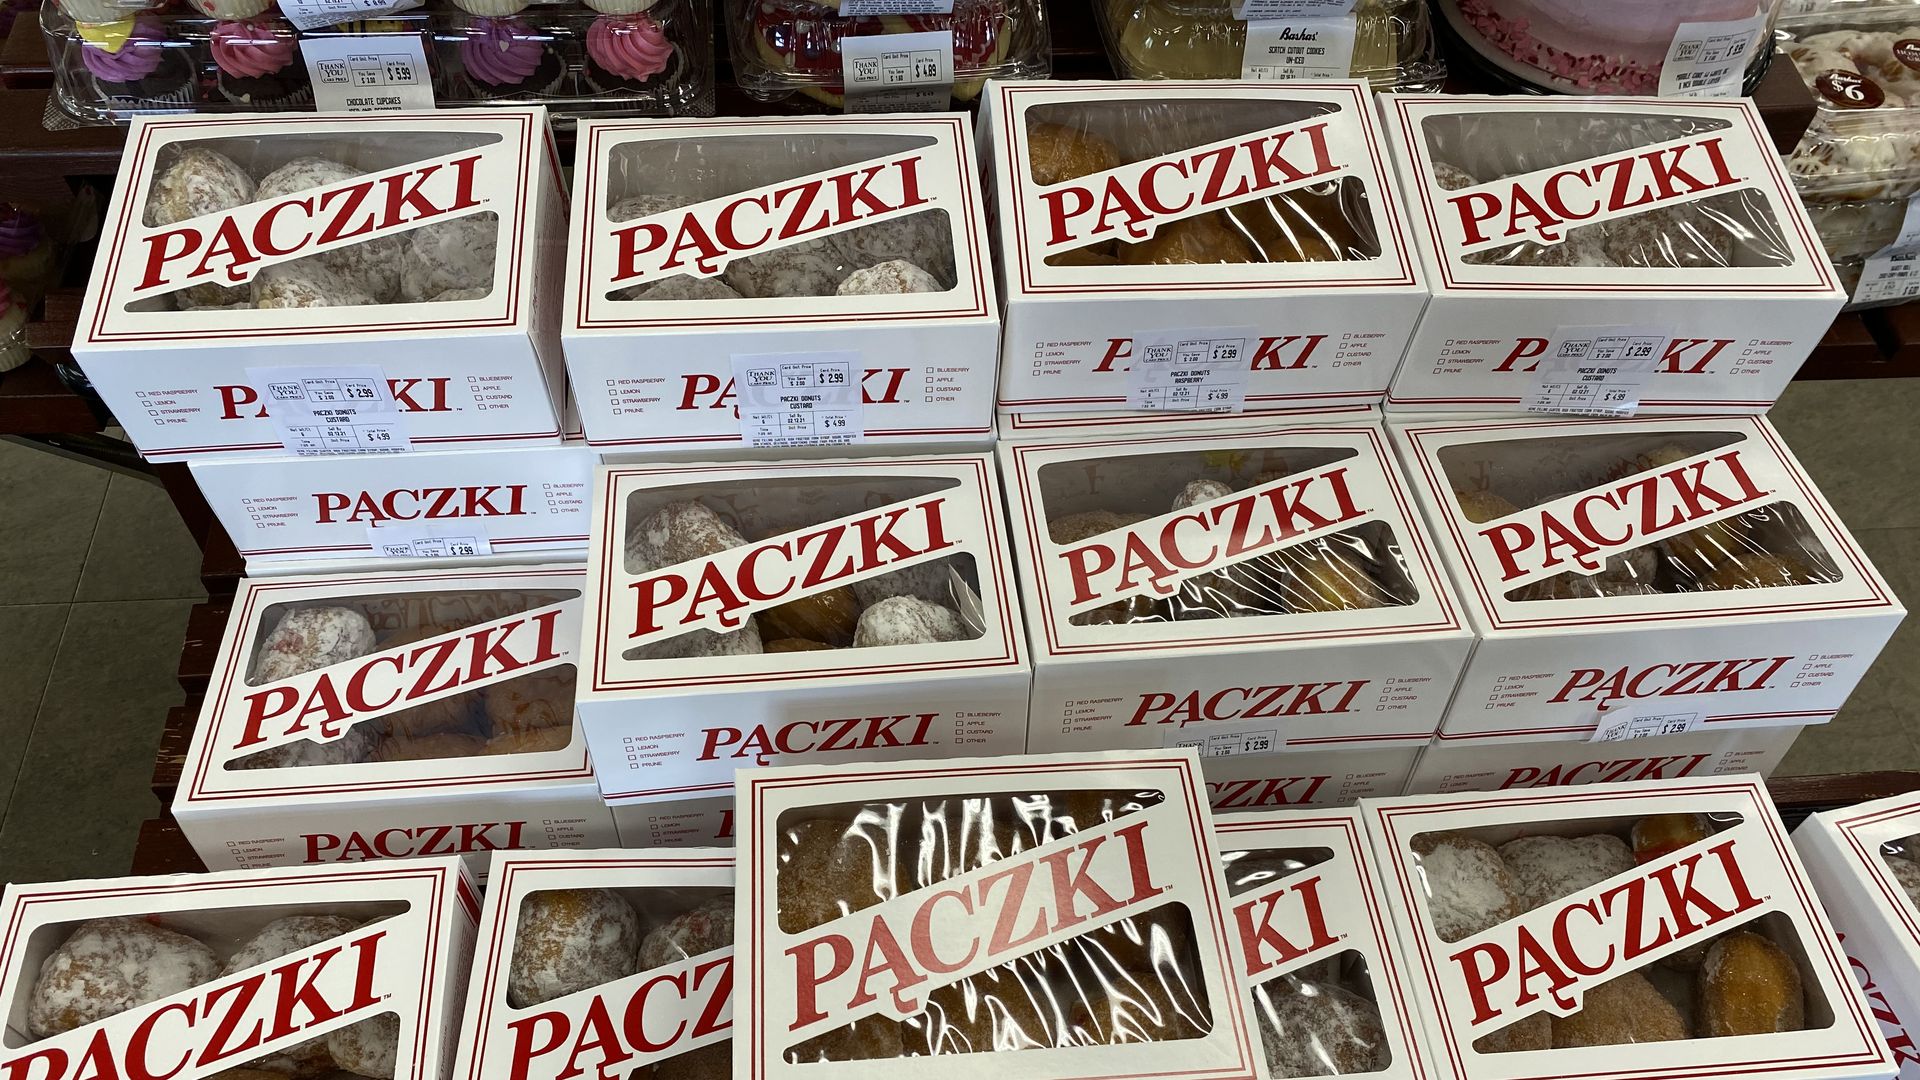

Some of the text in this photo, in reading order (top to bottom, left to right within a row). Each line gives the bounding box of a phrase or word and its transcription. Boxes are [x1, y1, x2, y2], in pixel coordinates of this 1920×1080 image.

[319, 62, 345, 70] THANK
[924, 64, 936, 76] 4.89
[325, 69, 343, 78] YOU
[396, 67, 411, 80] 5.99
[858, 68, 875, 76] YOU
[346, 97, 401, 106] CHOCOLATE CUPCAKES
[1221, 349, 1237, 358] 2.99
[1634, 347, 1652, 356] 2.99
[828, 373, 843, 383] 2.99
[358, 388, 374, 397] 2.99
[1670, 723, 1685, 733] 2.99
[1253, 740, 1268, 750] 2.99
